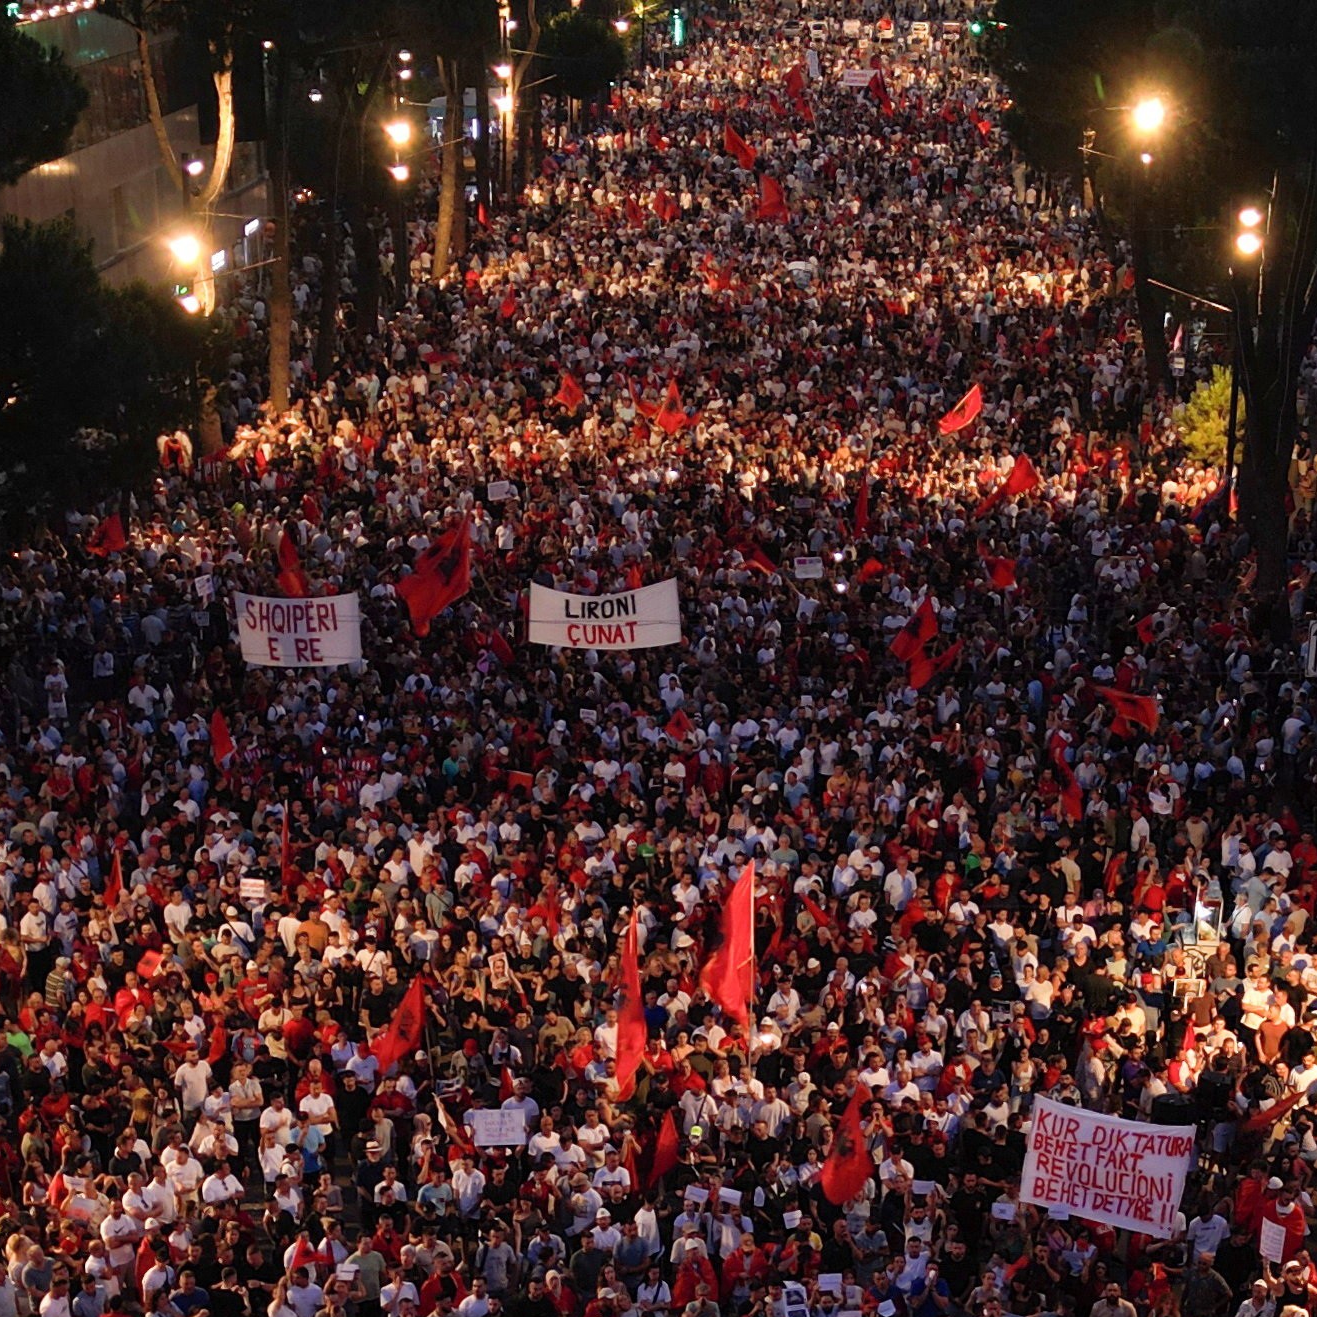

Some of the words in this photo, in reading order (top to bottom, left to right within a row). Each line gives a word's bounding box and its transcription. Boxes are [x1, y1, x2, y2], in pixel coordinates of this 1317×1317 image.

[244, 599, 338, 633] SHQIPËRI
[565, 594, 637, 619] LIRONI
[567, 621, 638, 646] ÇUNAT
[268, 637, 280, 661] E
[295, 637, 324, 662] RE
[1033, 1132, 1093, 1162] BEHET
[1036, 1108, 1080, 1143] KUR
[1091, 1125, 1193, 1158] DIKTATURA
[1032, 1177, 1090, 1208] BEHET
[1036, 1152, 1174, 1203] REVOLUCIONI
